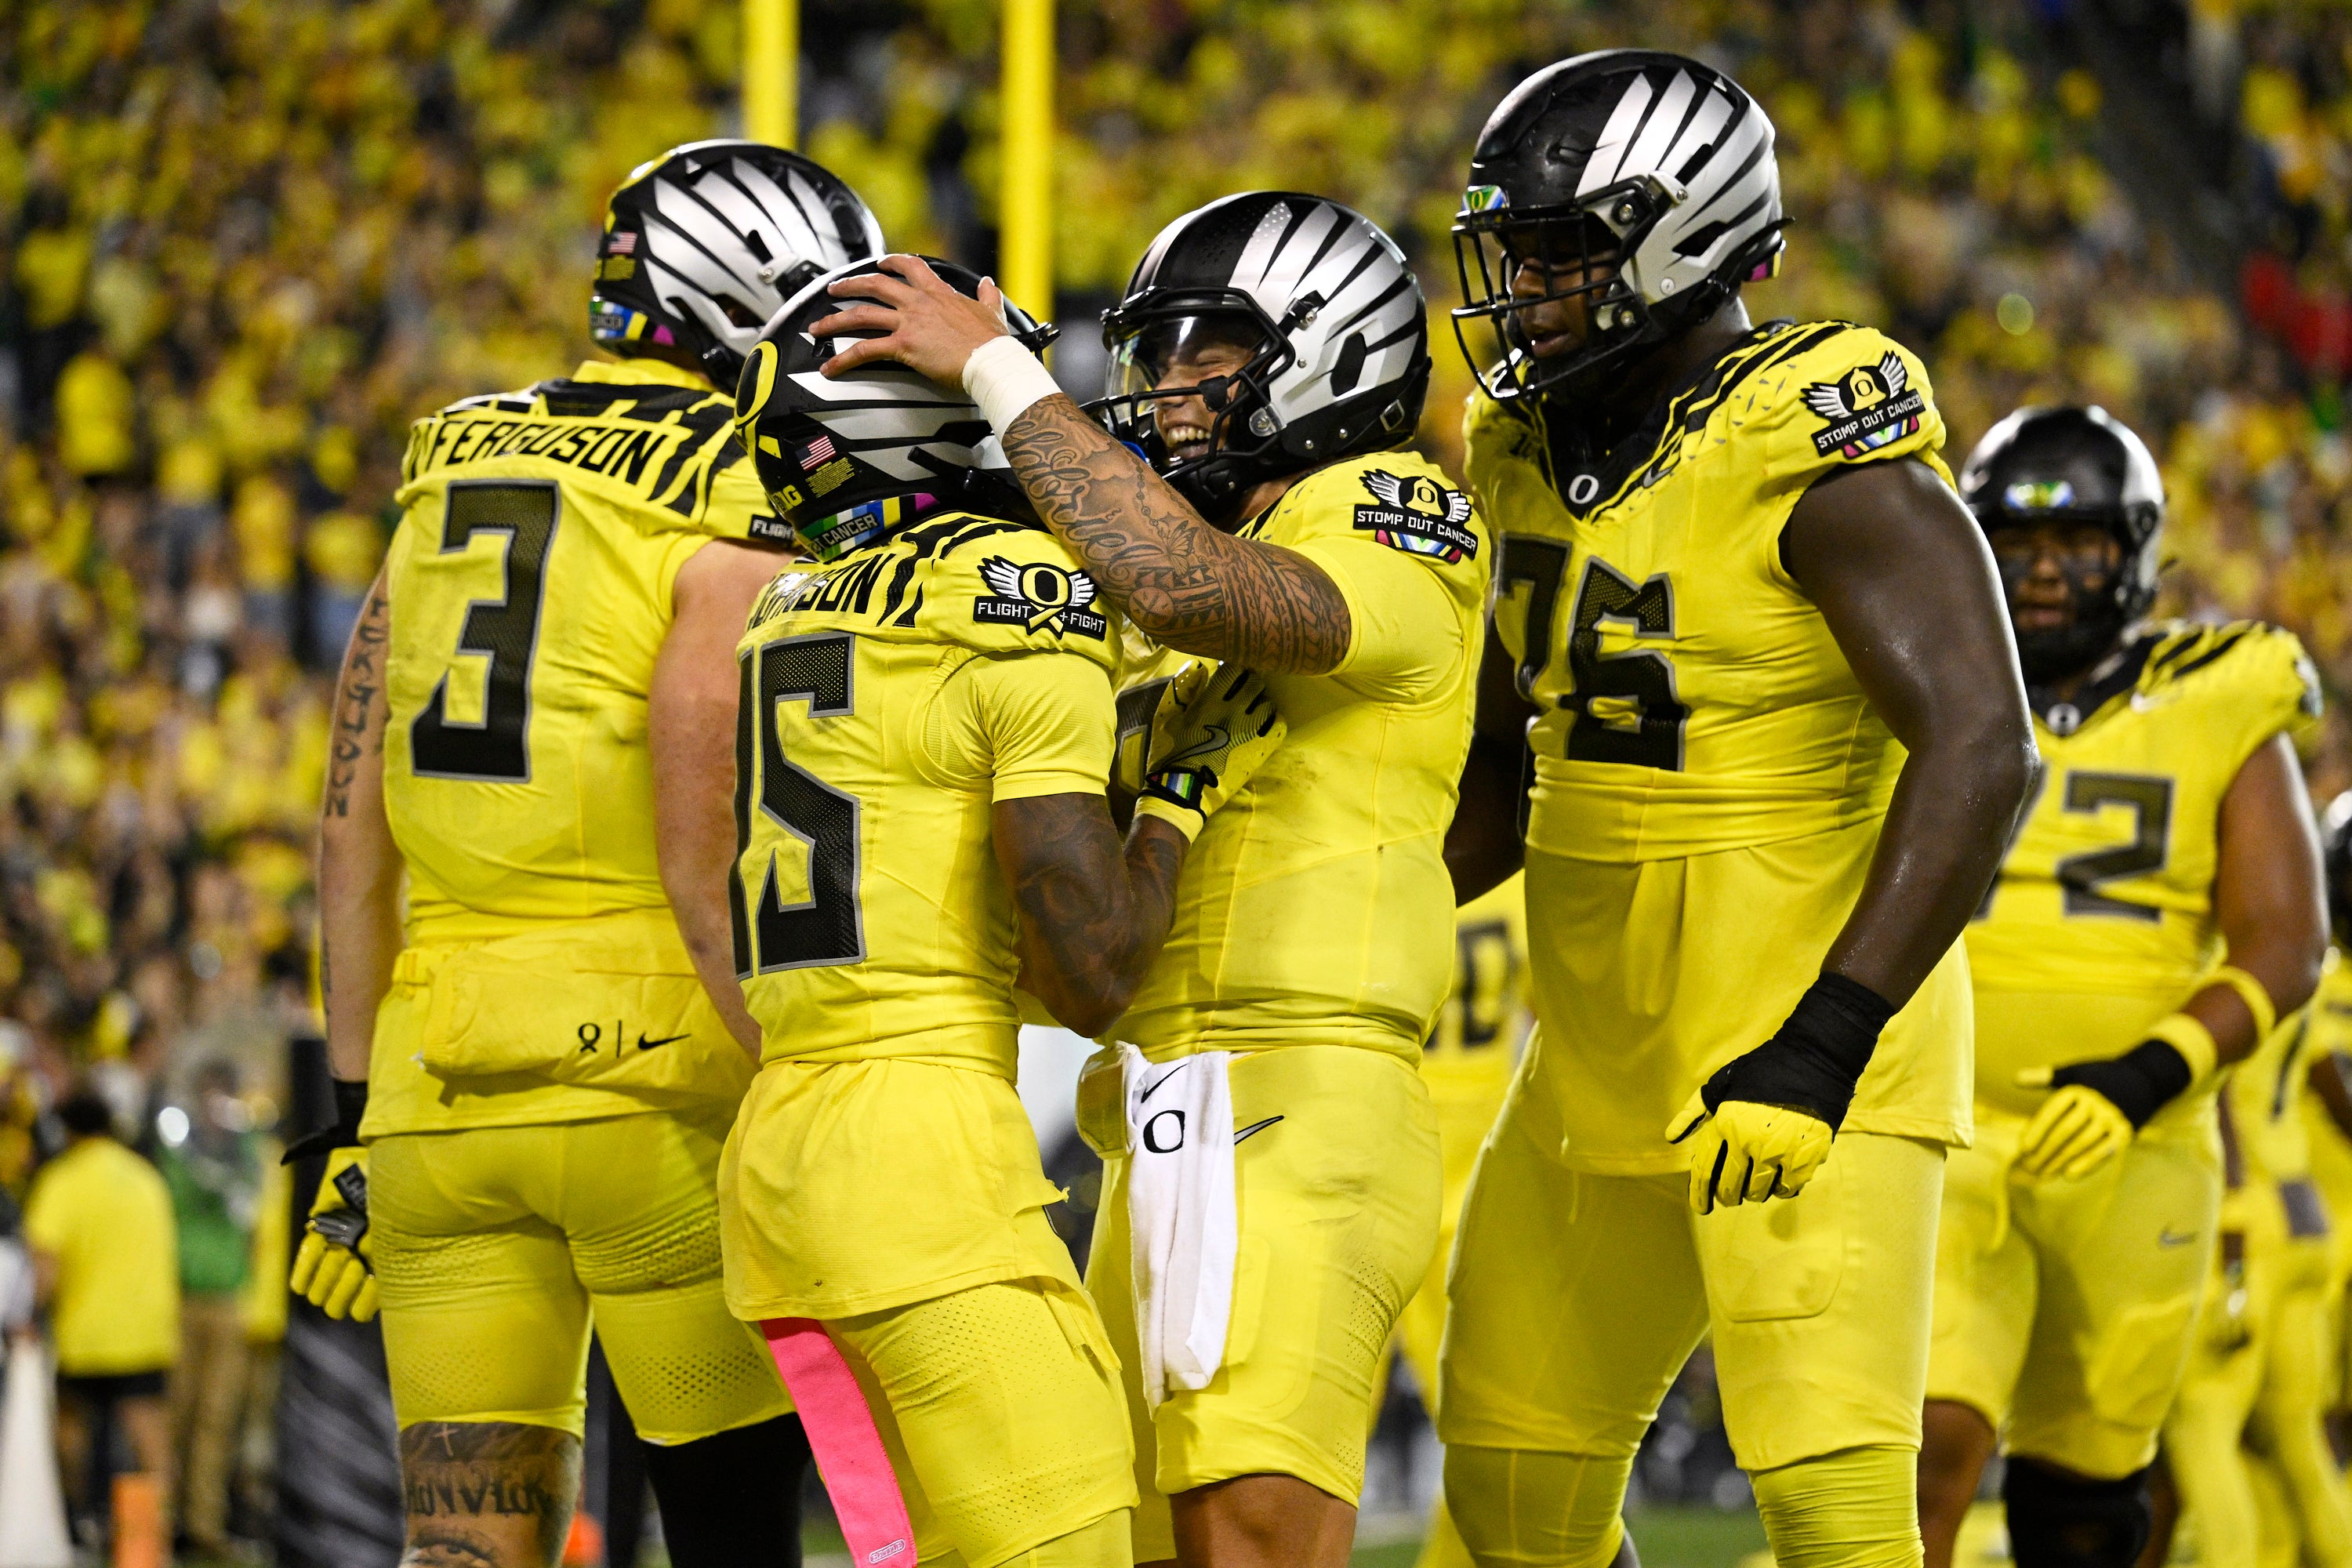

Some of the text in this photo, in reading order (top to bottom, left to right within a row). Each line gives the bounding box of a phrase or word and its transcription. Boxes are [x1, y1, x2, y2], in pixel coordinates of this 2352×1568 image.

[1817, 394, 1923, 449] STOMP OUT CANCER
[427, 420, 668, 487] FERGUSON
[822, 513, 879, 546] CANCER
[1357, 510, 1476, 552] STOMP OUT CANCER
[409, 479, 559, 782] 3
[978, 602, 1032, 619] FLIGHT
[1069, 612, 1105, 633] FIGHT
[1494, 529, 1690, 772] 76
[730, 630, 867, 983] 15
